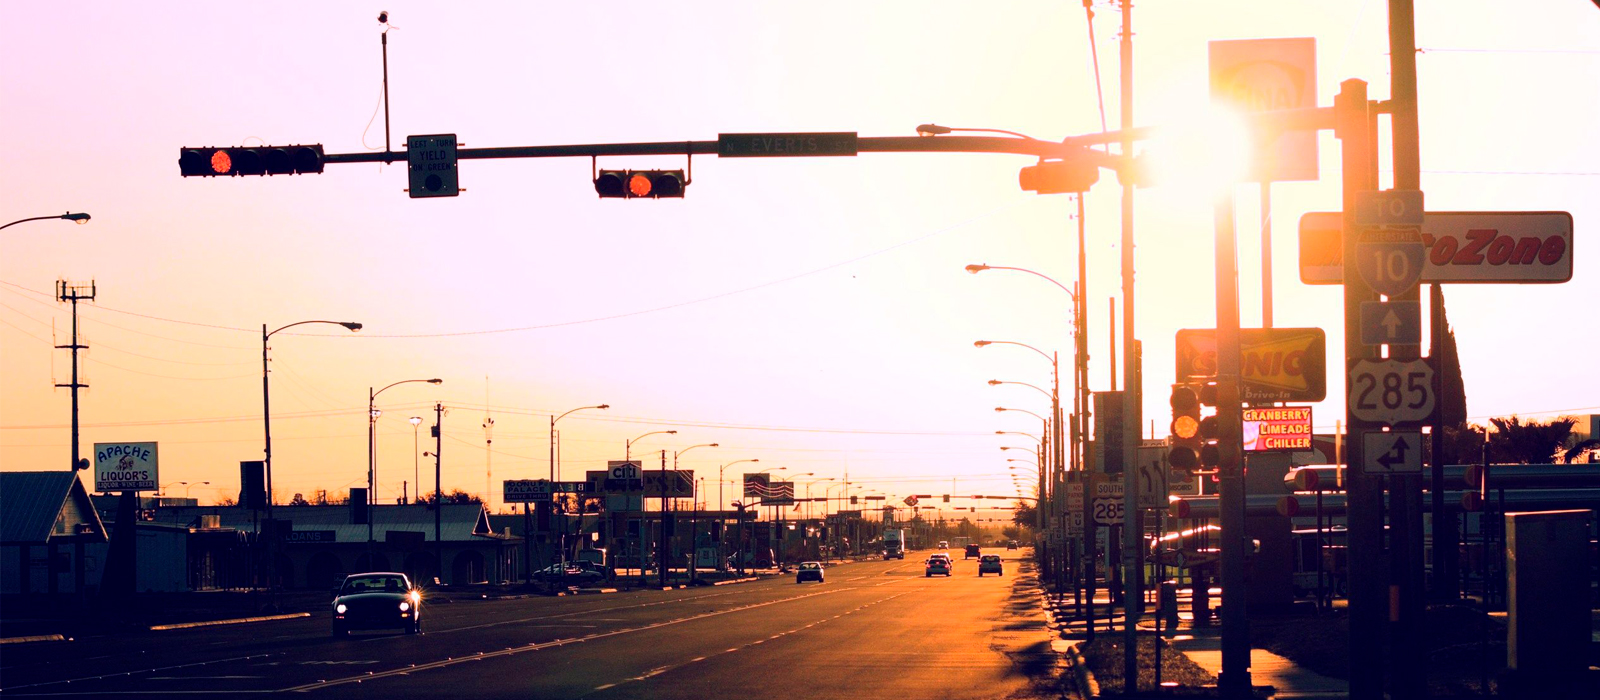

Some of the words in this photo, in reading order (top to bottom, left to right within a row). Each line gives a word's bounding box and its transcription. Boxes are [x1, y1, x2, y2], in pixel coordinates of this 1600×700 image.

[410, 140, 427, 148] LEFT
[436, 139, 453, 147] TURN
[727, 143, 734, 151] N
[752, 138, 817, 151] EVERTS
[419, 150, 446, 160] YIELD
[428, 162, 451, 171] GREEN
[1374, 198, 1404, 217] TO
[1365, 232, 1414, 242] INTERSTATE
[1422, 229, 1566, 266] oZone
[1374, 250, 1408, 281] 10
[1193, 349, 1306, 377] SNIC
[1356, 372, 1427, 410] 285
[1243, 410, 1309, 420] CRANBERRY
[1260, 424, 1310, 434] LIMEADE
[1265, 438, 1311, 448] CHILLER
[98, 445, 151, 463] APACHE
[101, 470, 148, 481] LIQUOR'S
[1098, 484, 1123, 493] SOUTH
[285, 532, 321, 541] LOANS
